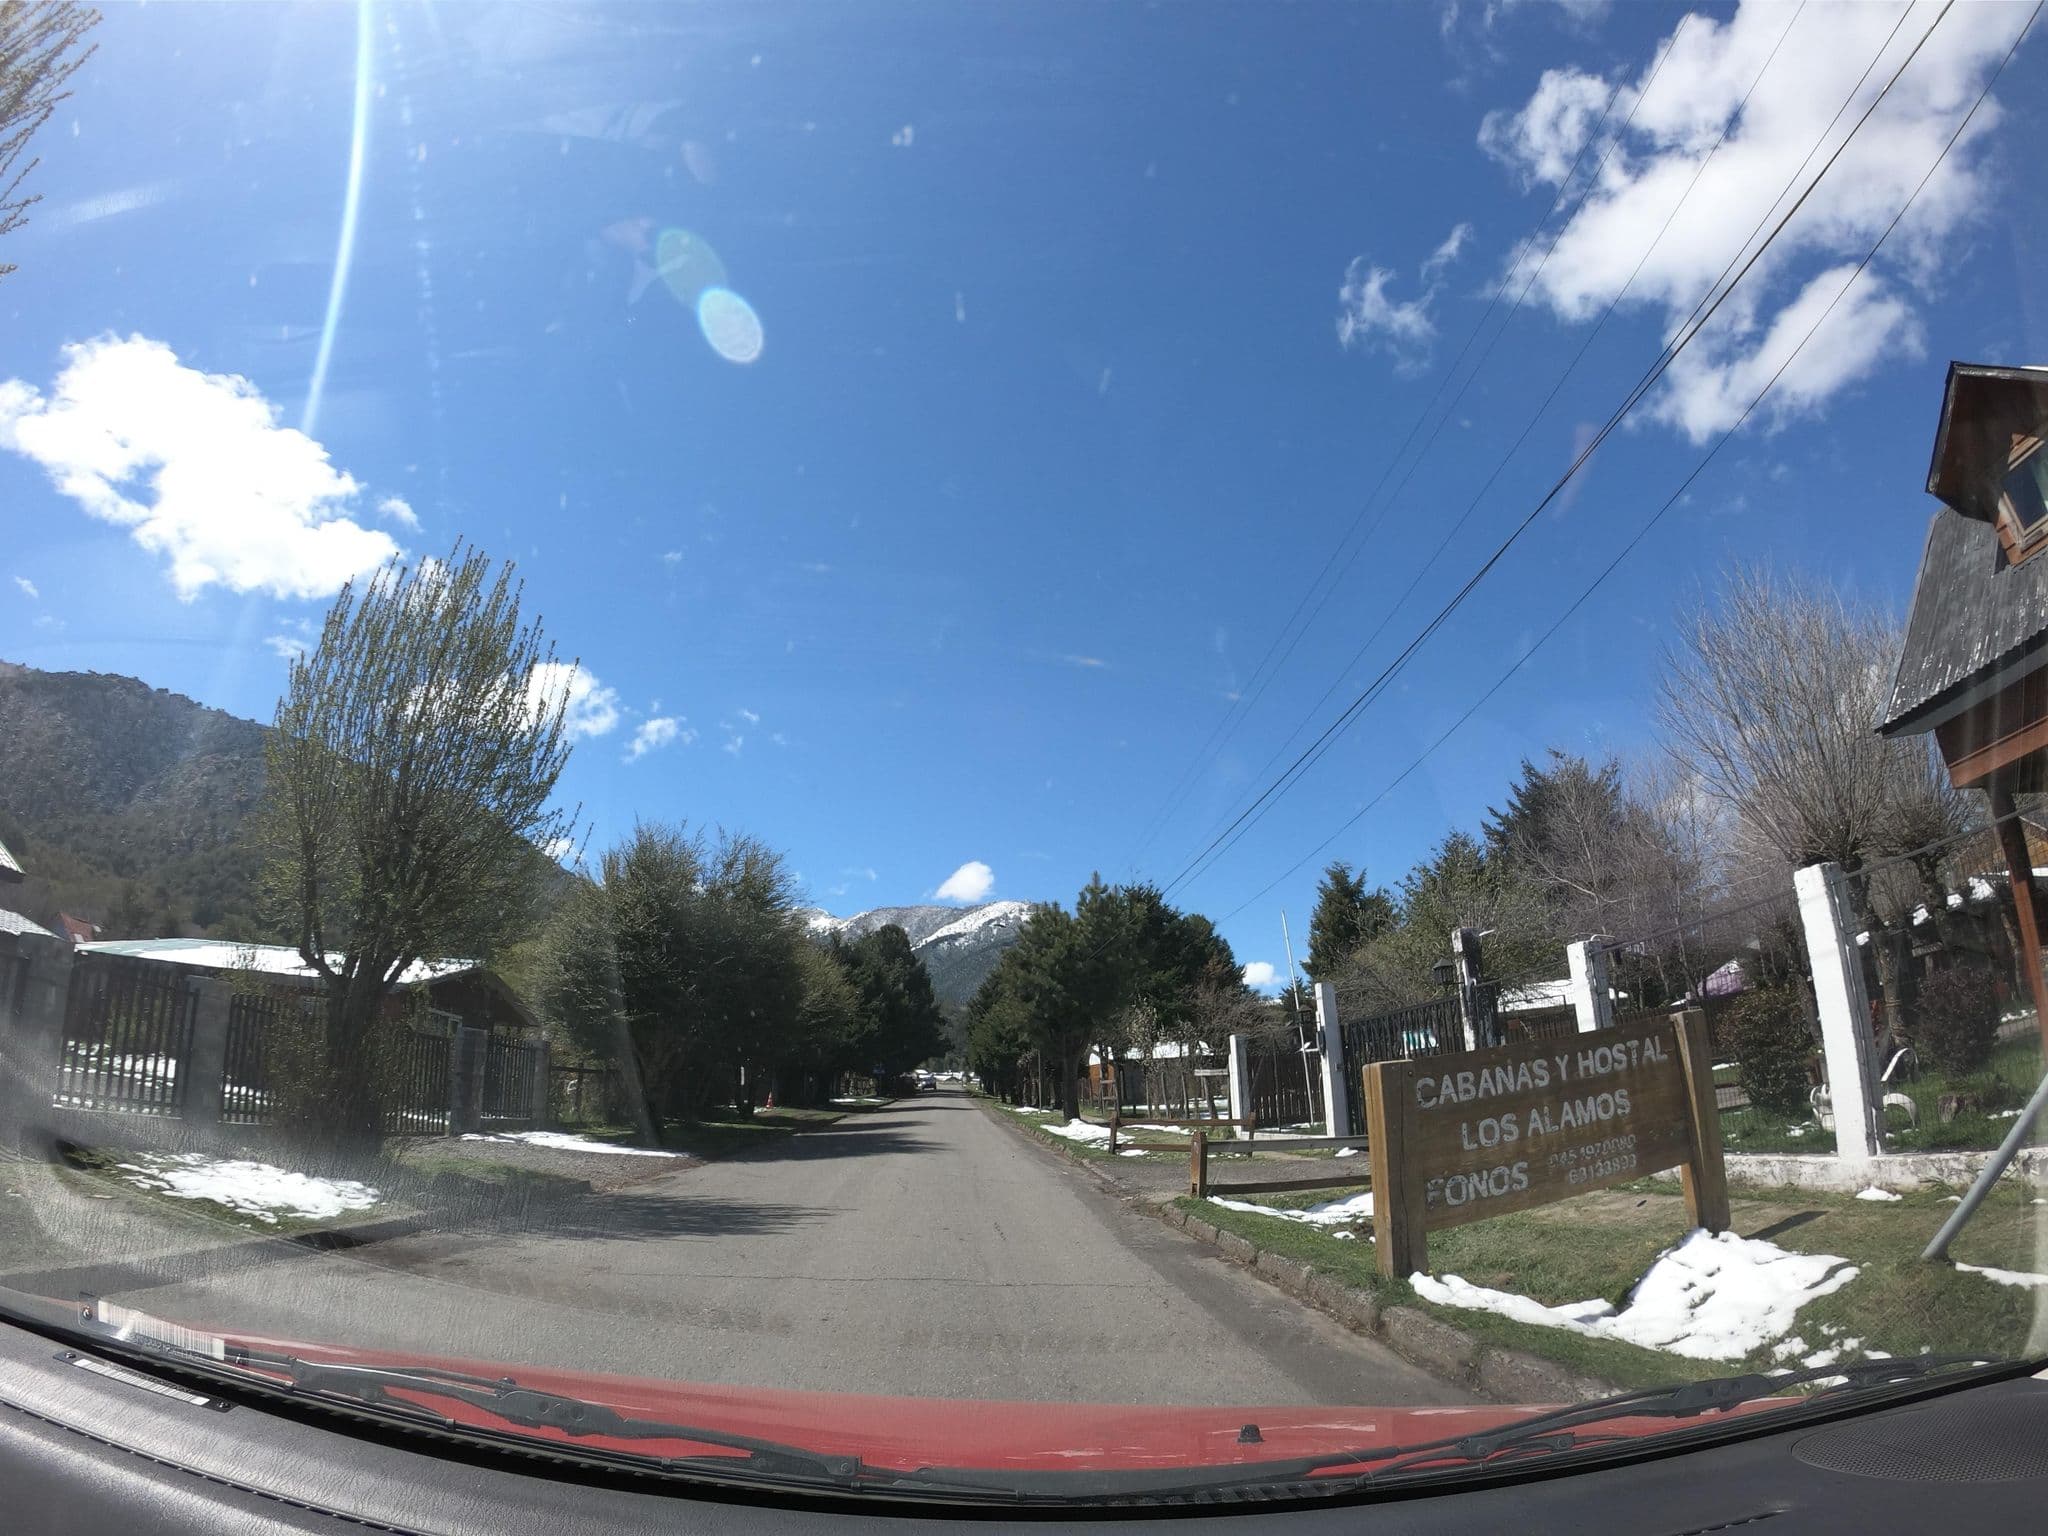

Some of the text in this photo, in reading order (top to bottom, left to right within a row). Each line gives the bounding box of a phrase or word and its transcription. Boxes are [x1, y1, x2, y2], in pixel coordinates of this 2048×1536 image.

[1555, 1054, 1569, 1081] Y
[1578, 1035, 1668, 1078] HOSTAL
[1461, 1089, 1631, 1150] LOS ALAMOS
[1427, 1161, 1529, 1209] FONOS
